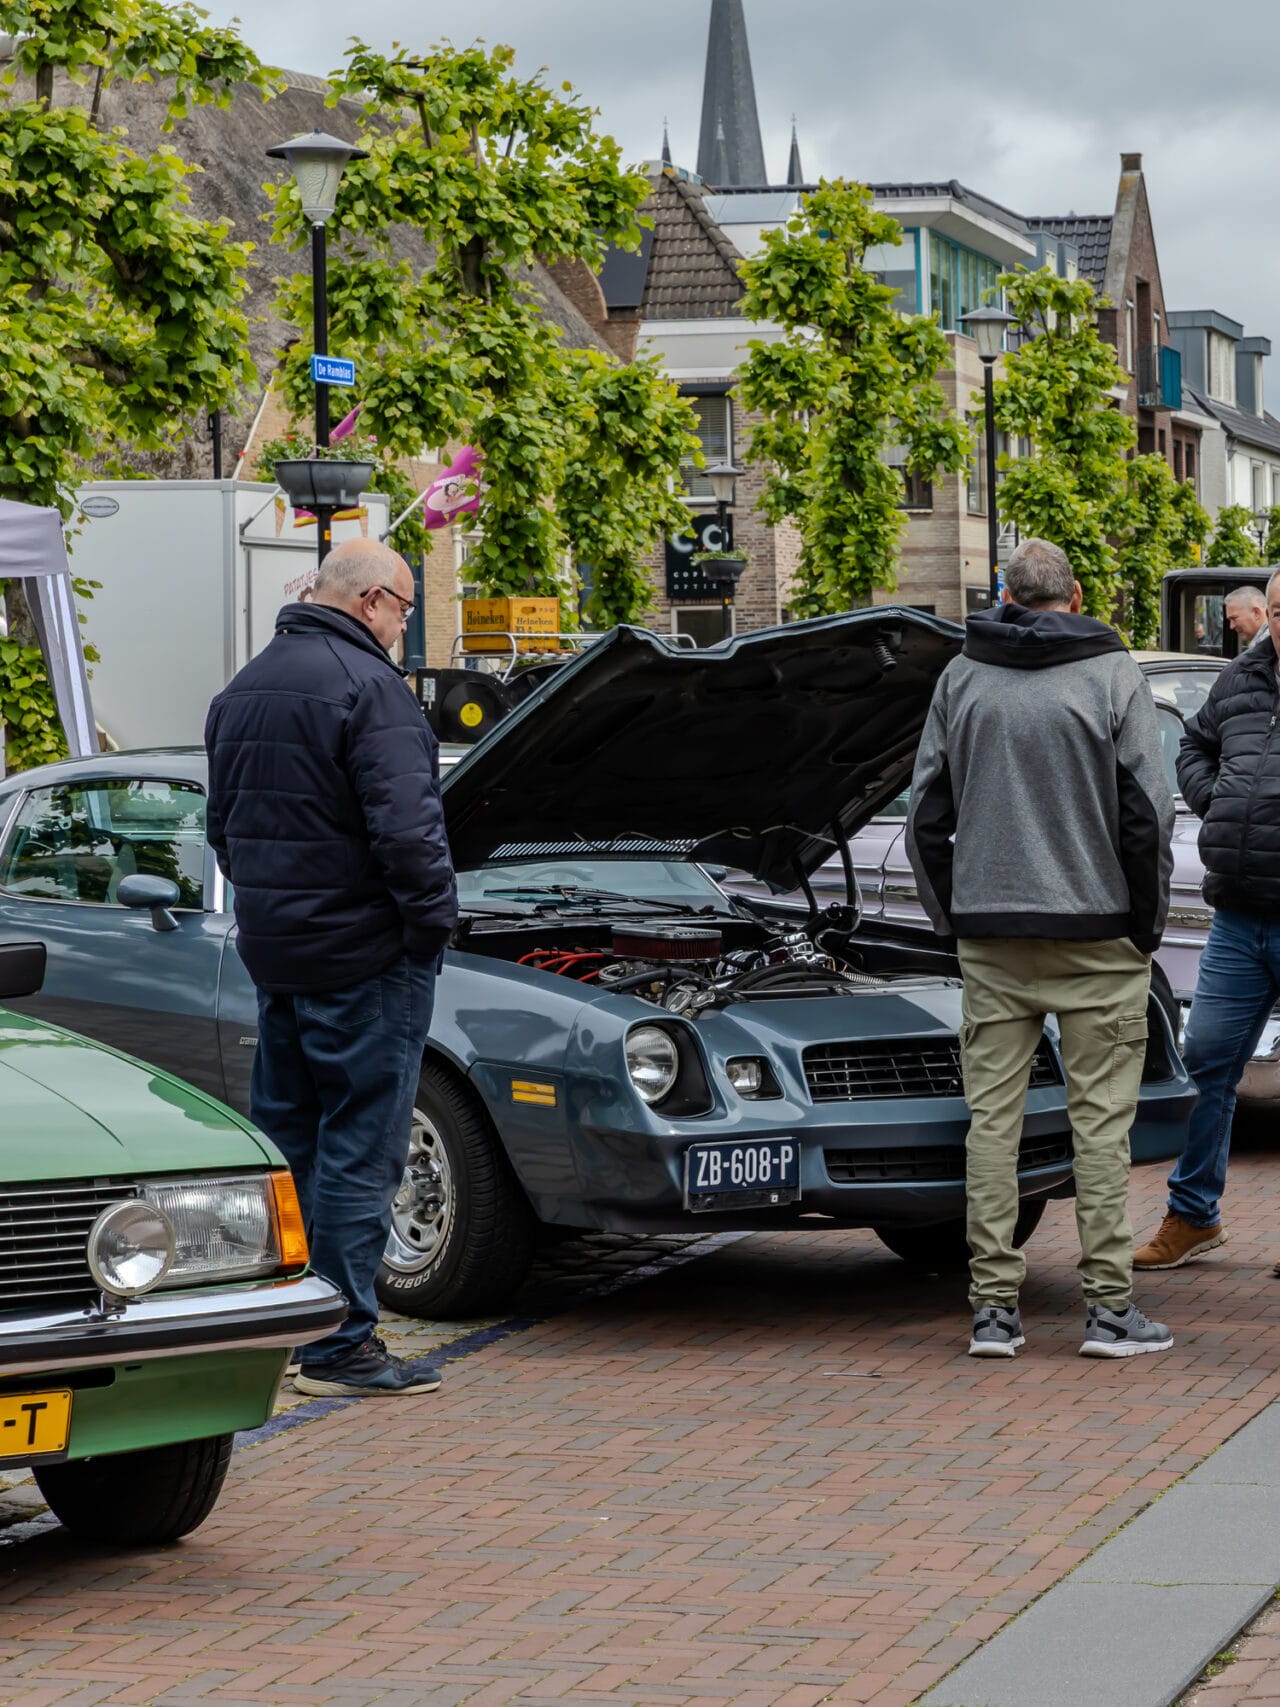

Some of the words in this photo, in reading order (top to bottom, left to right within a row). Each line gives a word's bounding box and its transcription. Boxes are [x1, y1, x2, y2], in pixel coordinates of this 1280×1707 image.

[318, 362, 326, 376] De
[327, 364, 352, 379] Ramblas
[466, 610, 505, 625] Heineken
[516, 617, 553, 625] Heineken
[696, 1145, 793, 1187] ZB-608-P
[386, 1269, 431, 1289] COBRA
